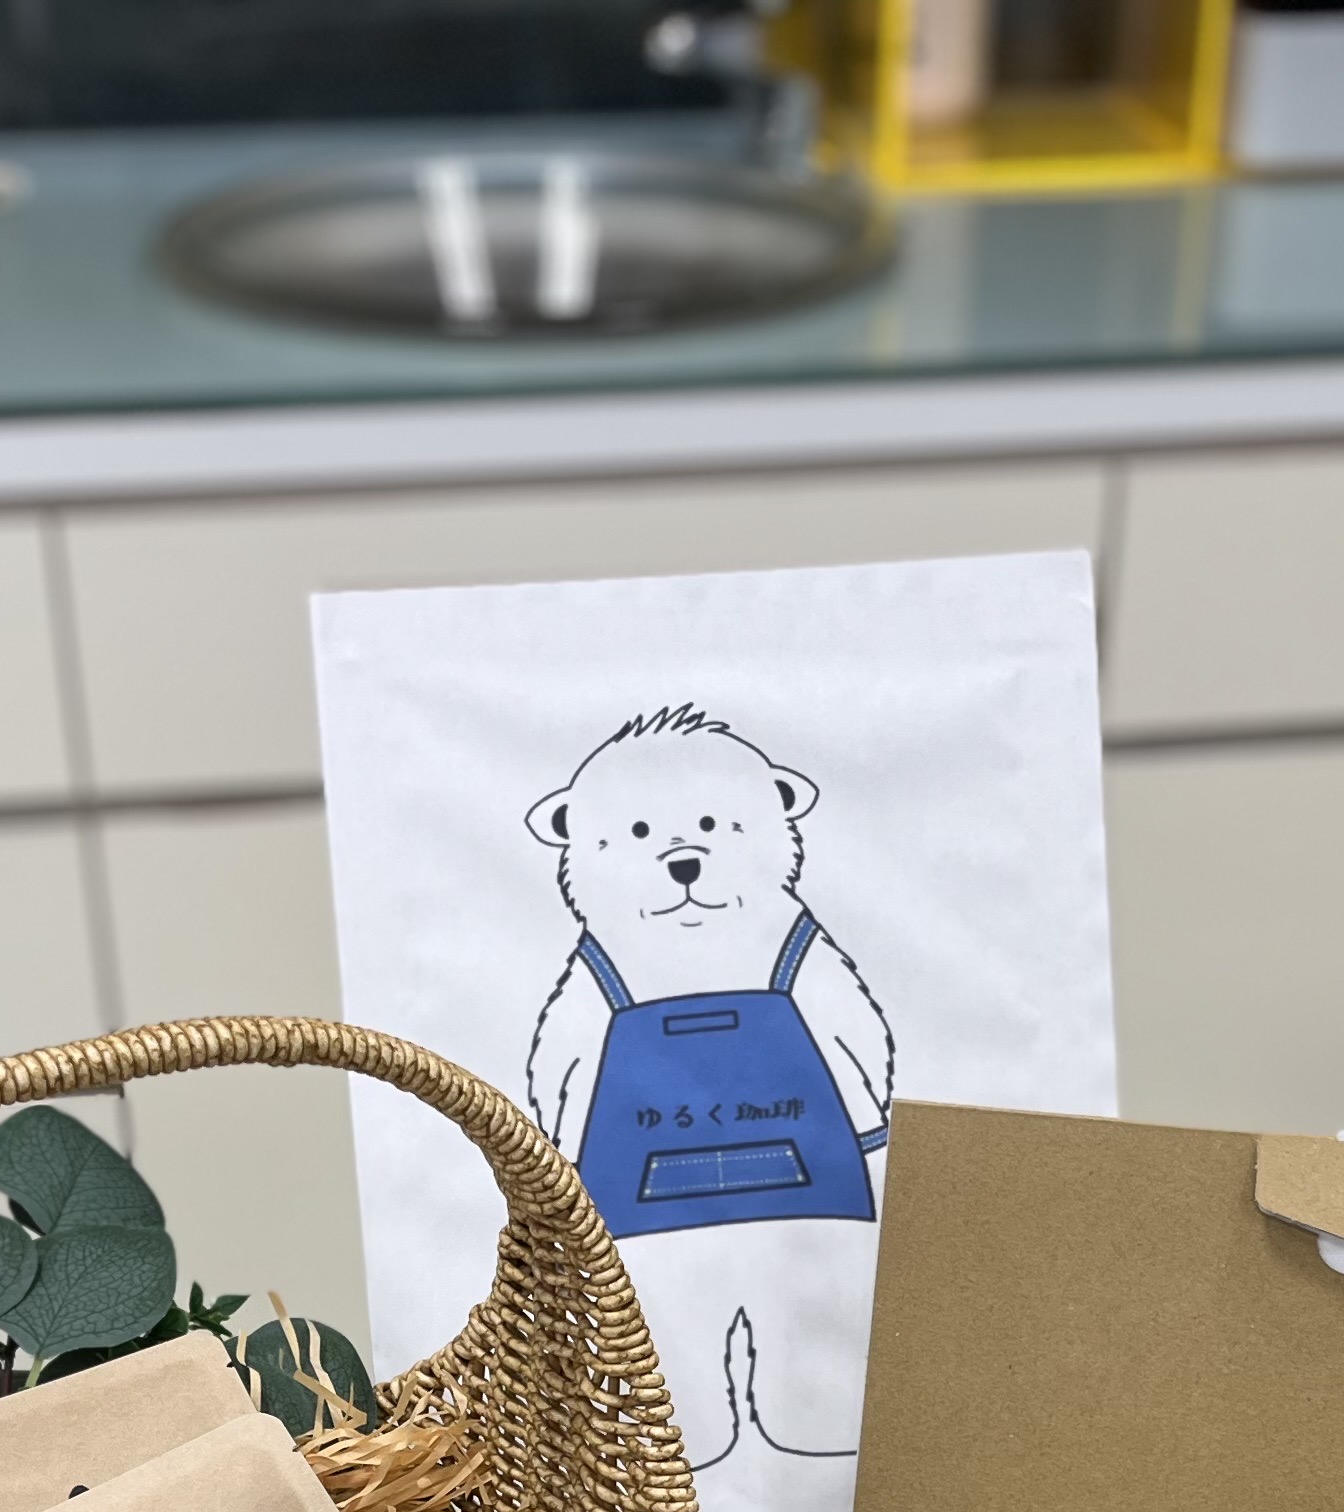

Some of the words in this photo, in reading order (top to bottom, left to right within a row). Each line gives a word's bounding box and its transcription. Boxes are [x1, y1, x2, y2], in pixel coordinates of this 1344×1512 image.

[636, 1097, 806, 1130] ゆるく珈琲
